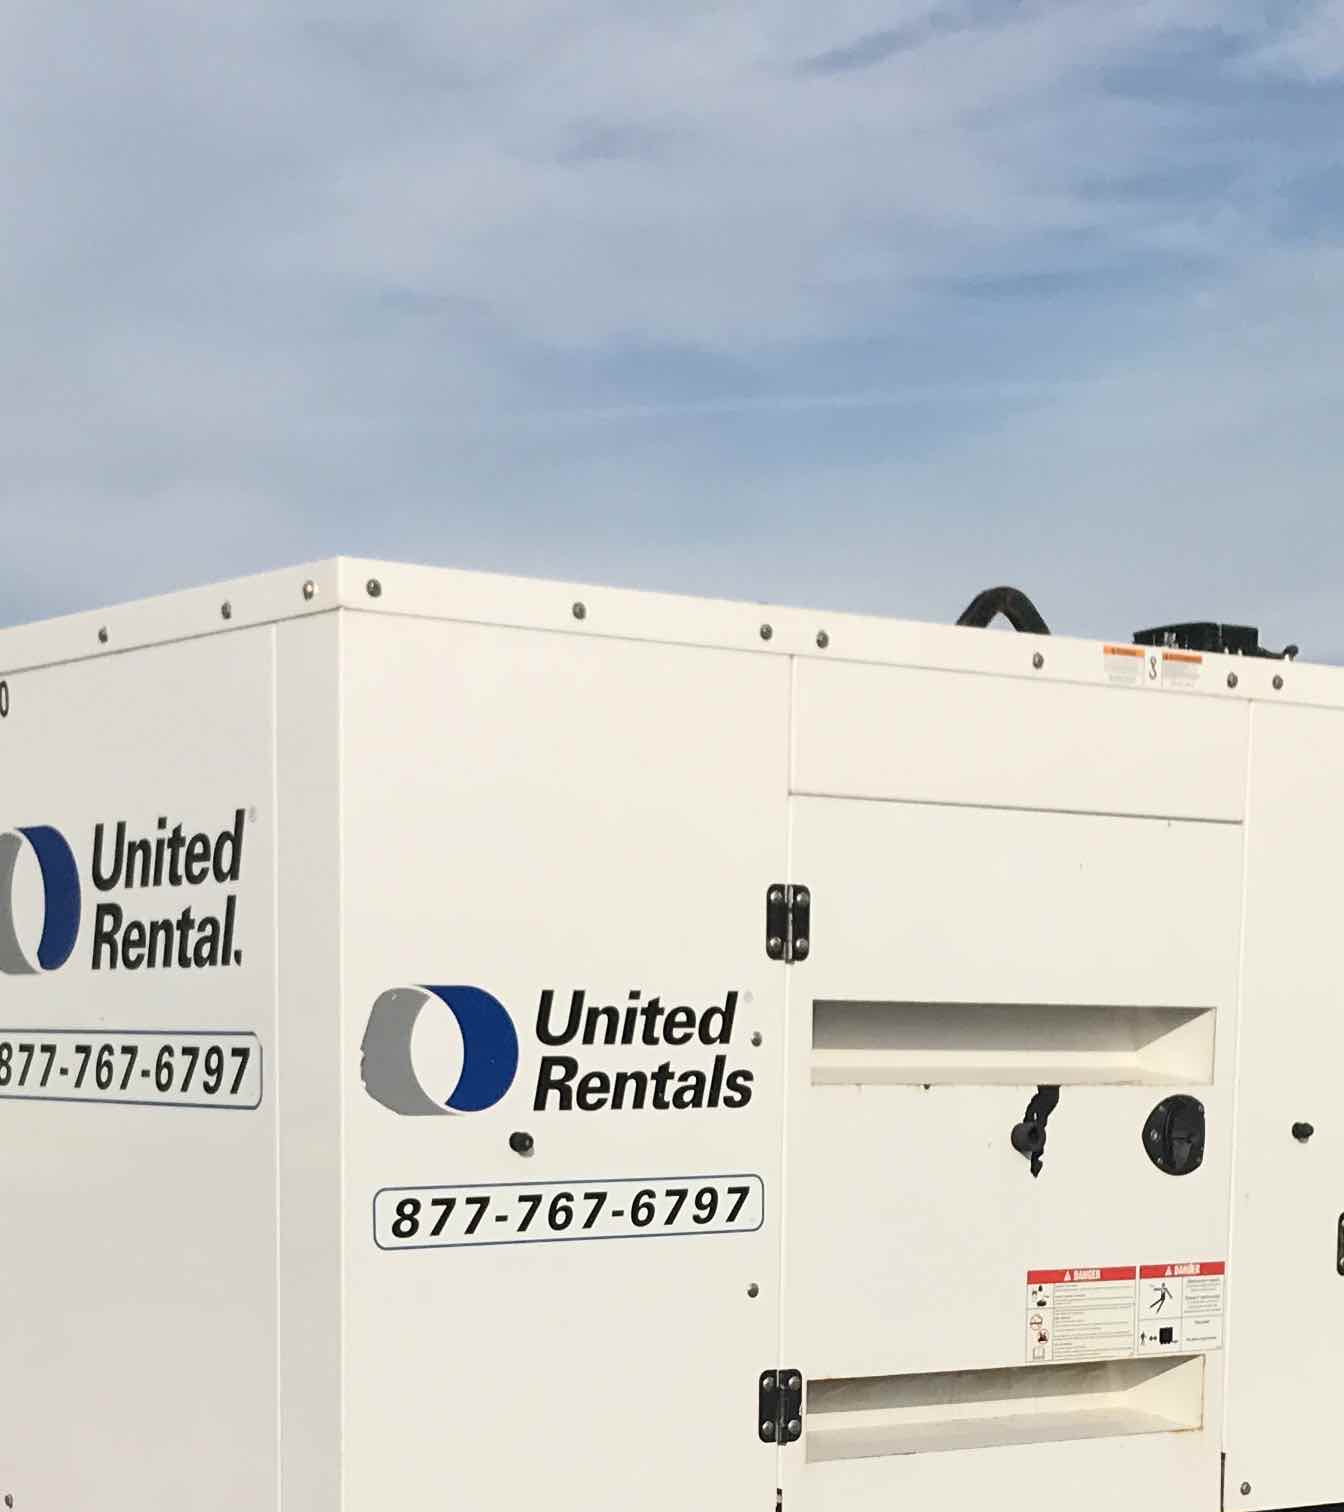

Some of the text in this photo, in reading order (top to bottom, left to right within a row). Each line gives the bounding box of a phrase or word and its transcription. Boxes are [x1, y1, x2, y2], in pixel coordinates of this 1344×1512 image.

[91, 808, 246, 891] United
[91, 895, 242, 970] Rental
[535, 989, 739, 1046] United
[533, 1055, 754, 1111] Rentals
[391, 1186, 750, 1239] 877-767-6797
